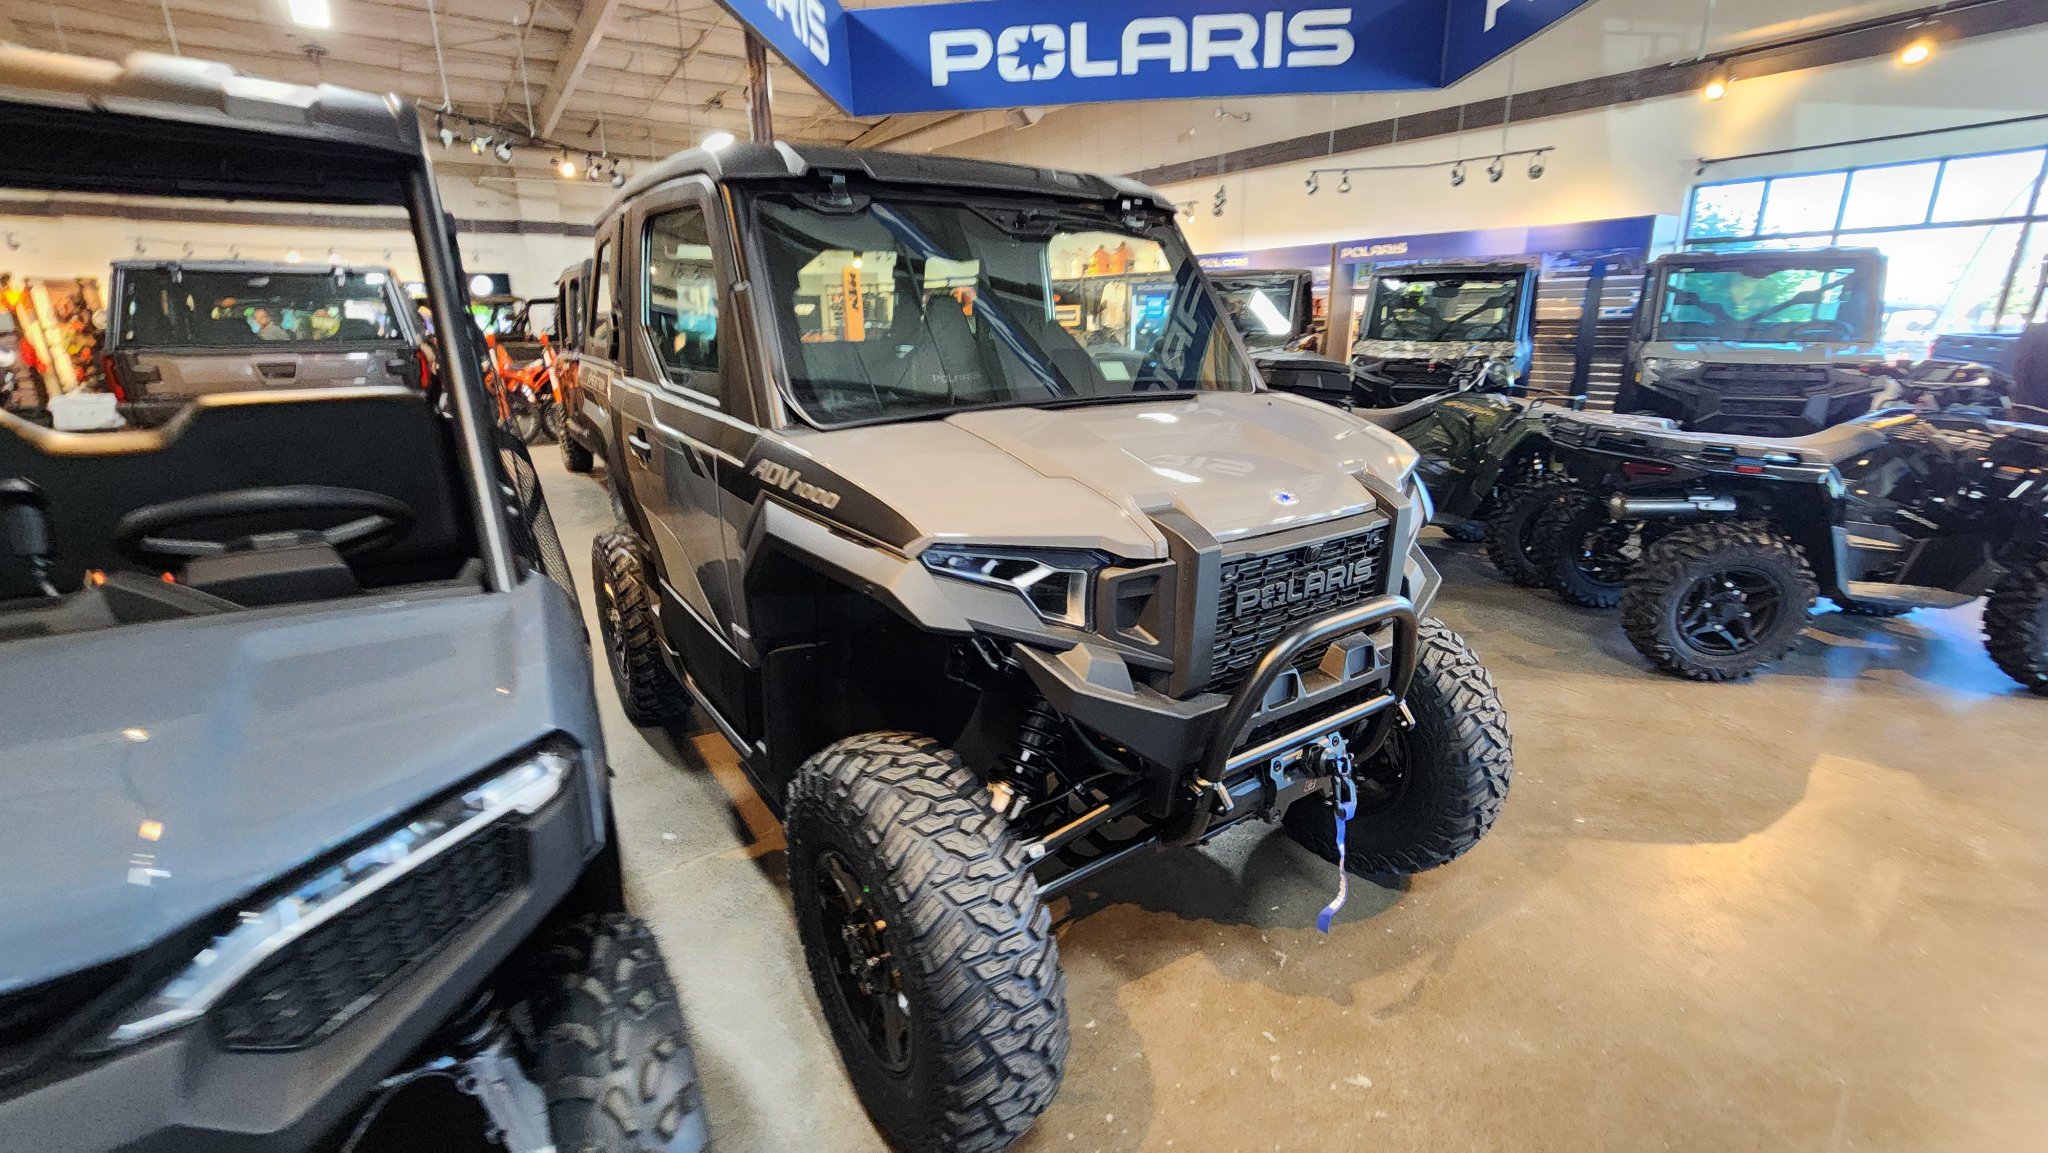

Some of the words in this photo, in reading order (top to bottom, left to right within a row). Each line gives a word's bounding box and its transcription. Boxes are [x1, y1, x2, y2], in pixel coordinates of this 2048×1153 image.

[929, 8, 1356, 87] POLARIS
[1340, 241, 1408, 260] POLARIS
[1235, 557, 1373, 618] POLARIS
